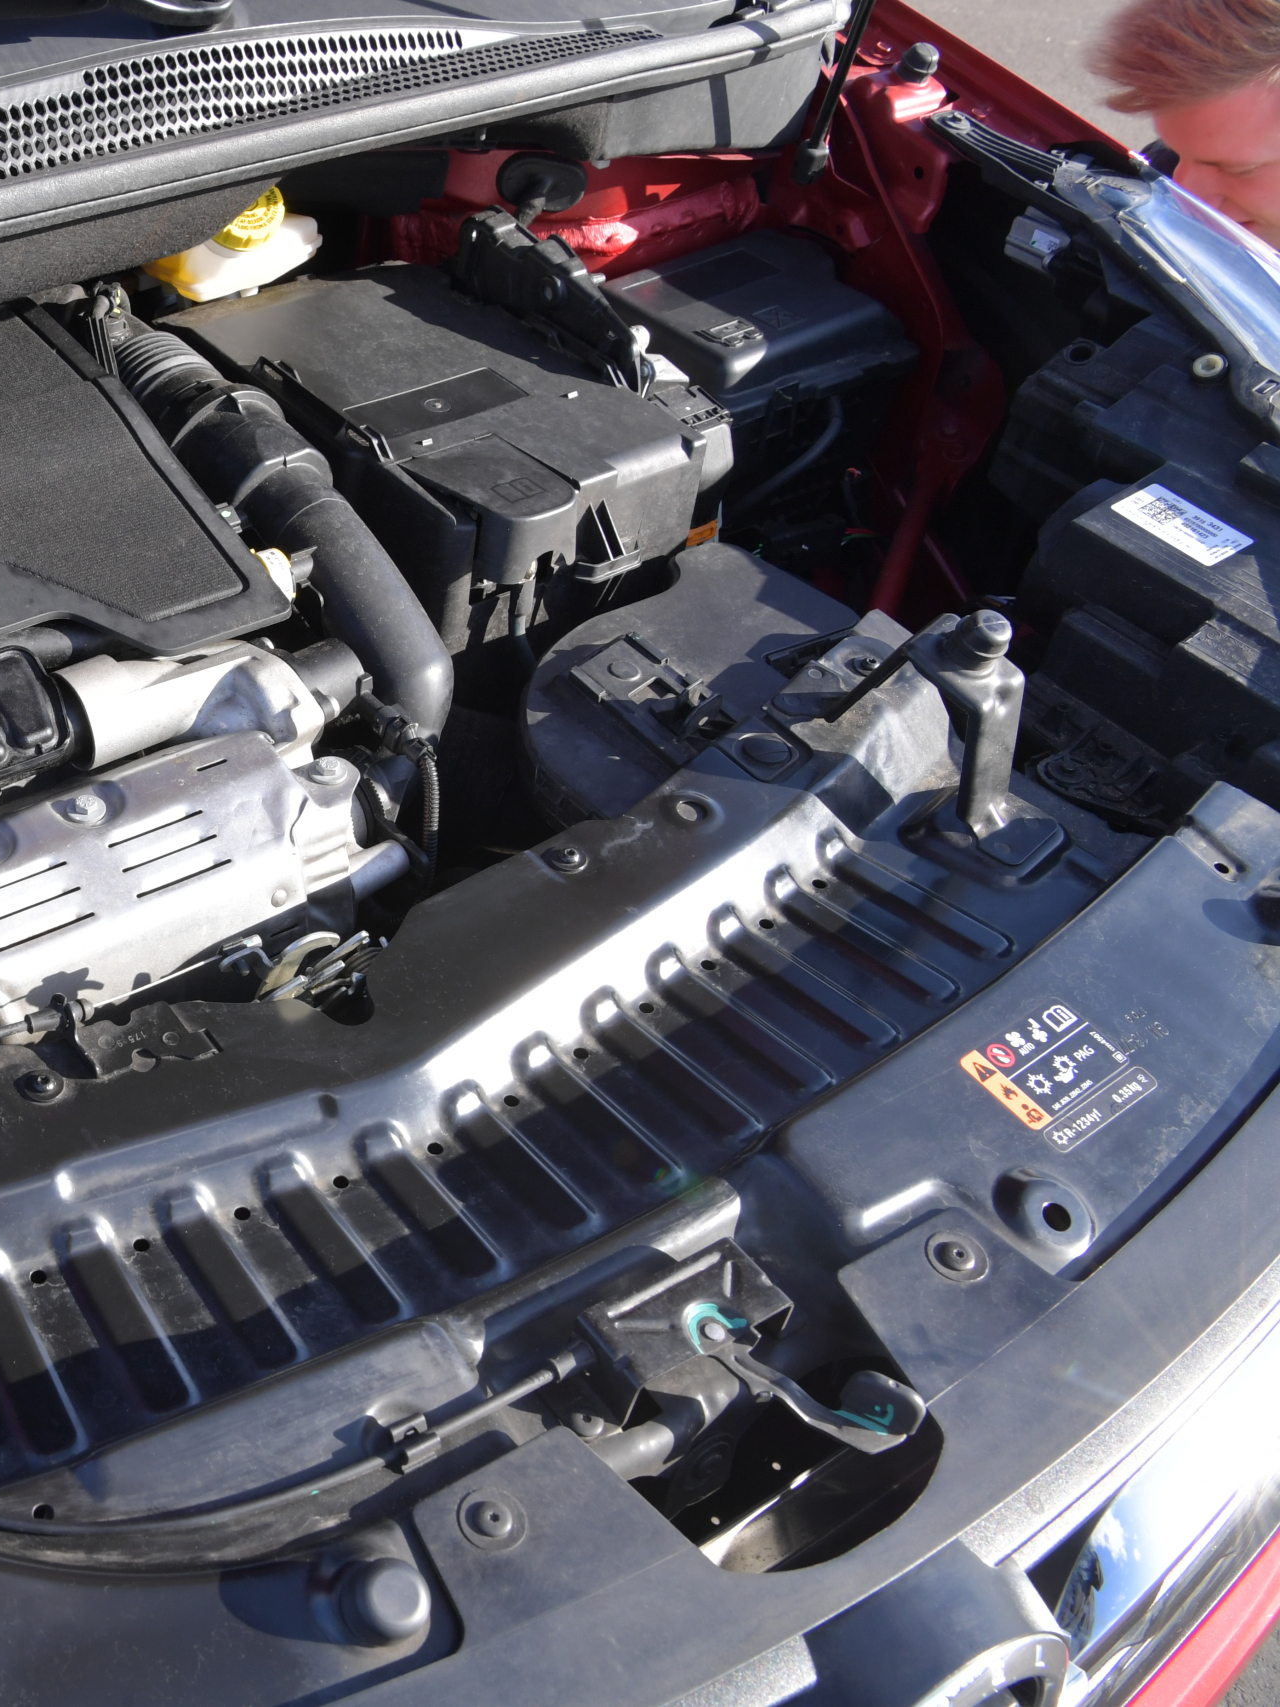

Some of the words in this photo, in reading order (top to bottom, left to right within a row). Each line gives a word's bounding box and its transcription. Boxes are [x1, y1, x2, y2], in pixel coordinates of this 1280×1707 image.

[1207, 521, 1223, 532] 3431
[1019, 1042, 1035, 1056] AUTO
[1073, 1045, 1095, 1061] PAG
[1052, 1102, 1060, 1111] SAE
[1064, 1109, 1103, 1138] R-1234yf
[1112, 1081, 1142, 1104] 0.35kg
